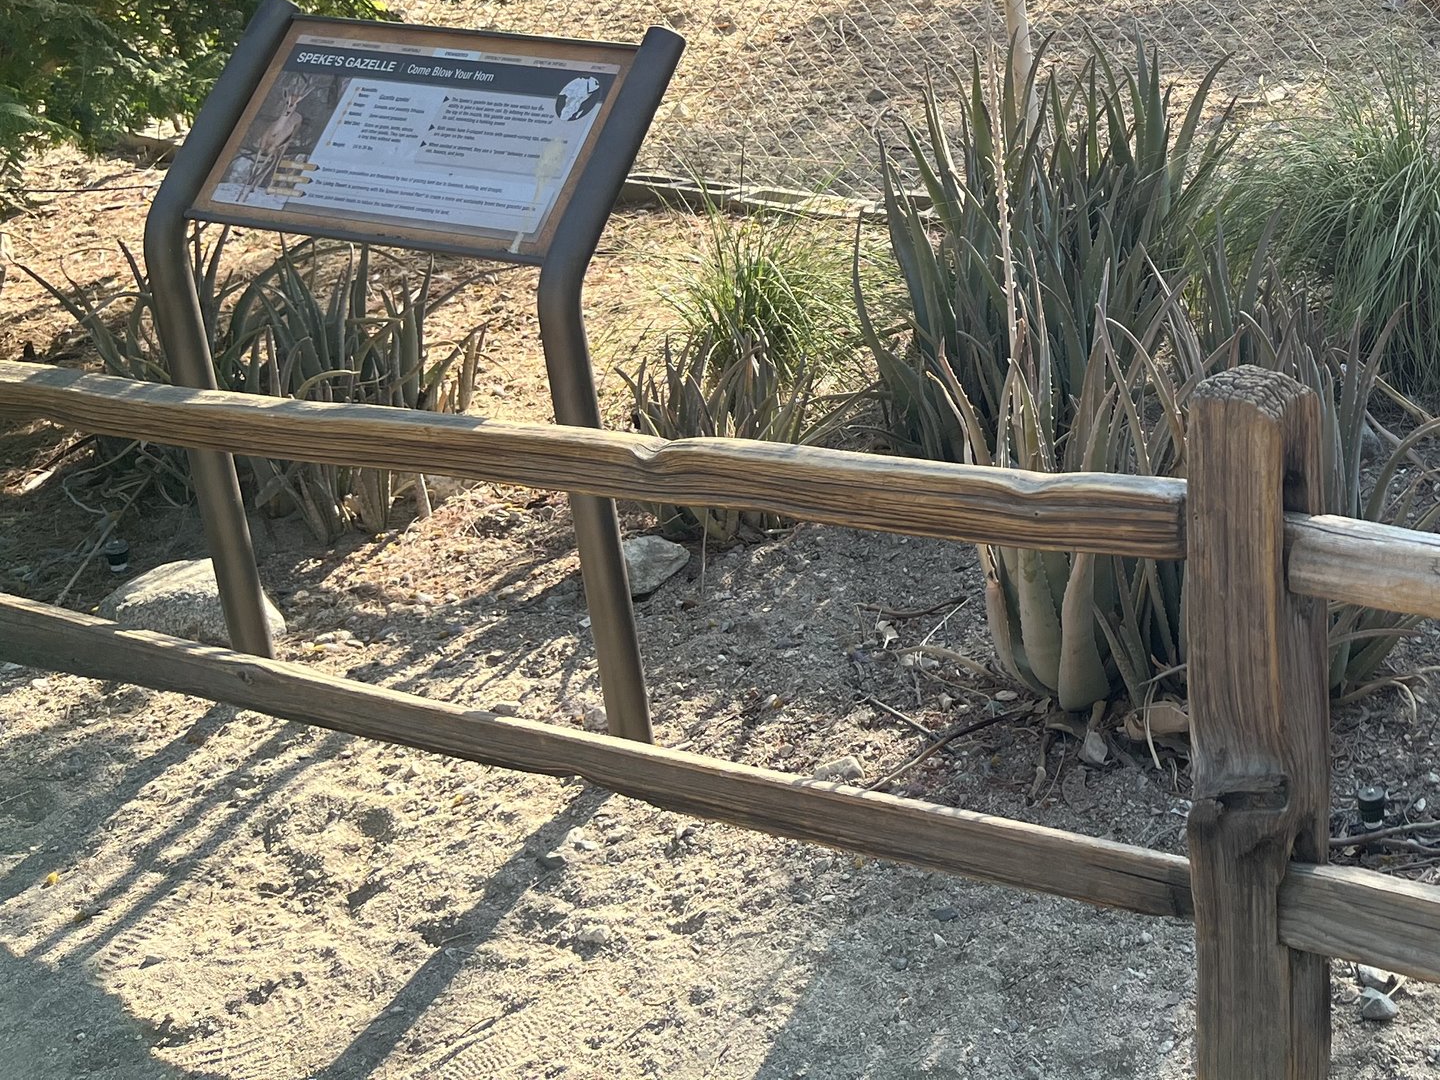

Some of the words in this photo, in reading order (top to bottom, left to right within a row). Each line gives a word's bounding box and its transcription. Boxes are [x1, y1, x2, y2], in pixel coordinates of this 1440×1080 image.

[295, 52, 345, 66] SPEKE'S
[343, 57, 397, 71] GAZELLE
[405, 64, 432, 75] Come
[430, 66, 454, 77] Blow
[452, 69, 473, 79] Your
[472, 71, 495, 81] Horn
